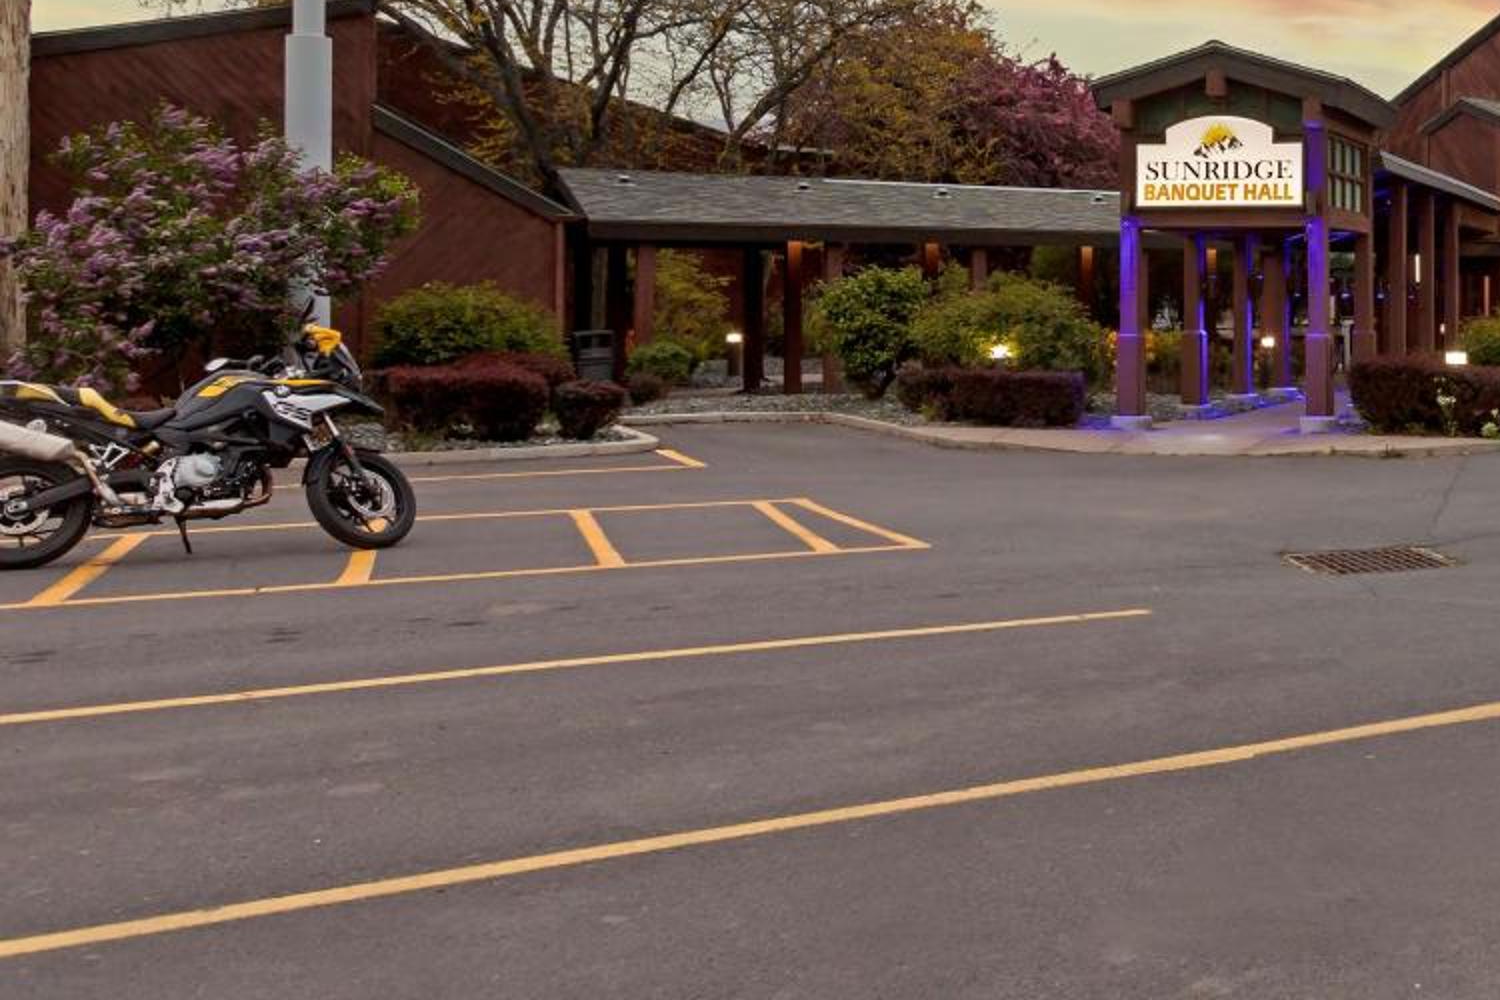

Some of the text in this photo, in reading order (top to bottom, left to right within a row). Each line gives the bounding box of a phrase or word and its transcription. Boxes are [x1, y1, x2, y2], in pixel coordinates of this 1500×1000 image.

[1145, 159, 1294, 181] SUNRIDGE
[1143, 183, 1294, 201] BANQUET HALL
